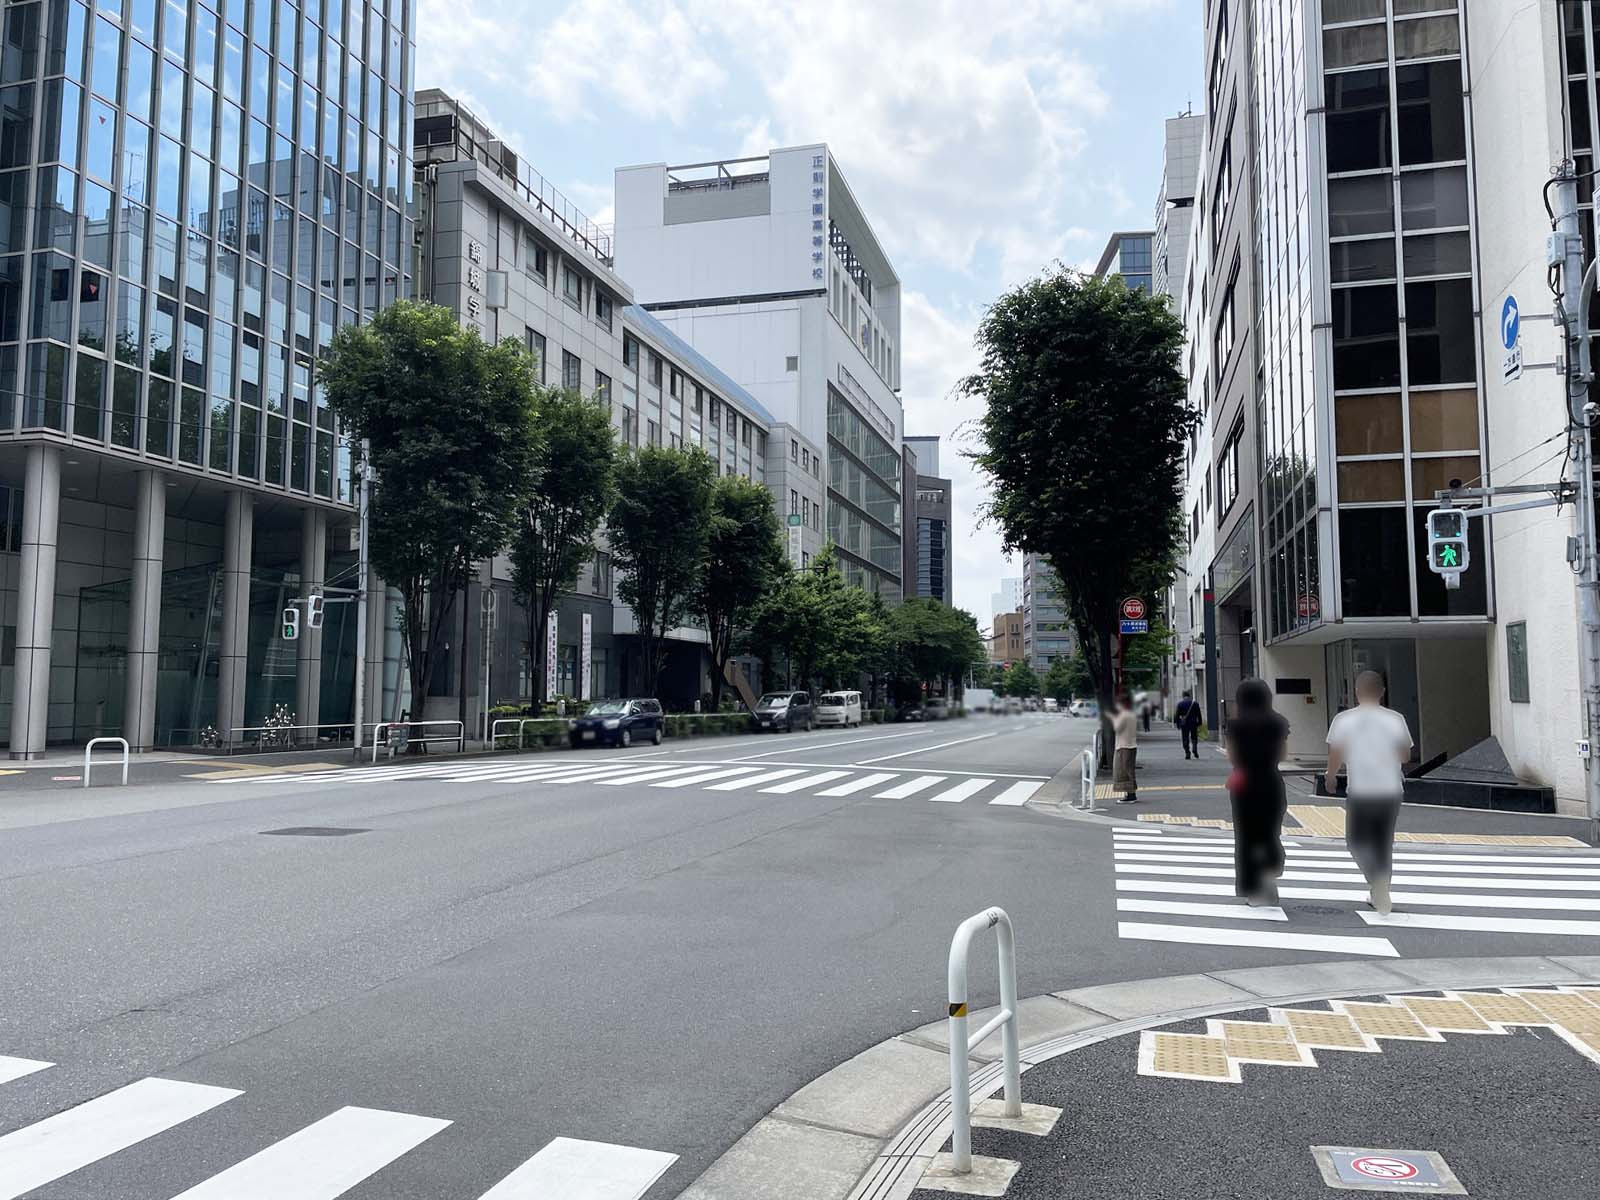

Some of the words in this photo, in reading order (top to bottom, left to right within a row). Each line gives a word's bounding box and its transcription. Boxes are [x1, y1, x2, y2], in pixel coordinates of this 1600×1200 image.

[812, 155, 823, 280] 正則学園高等学校
